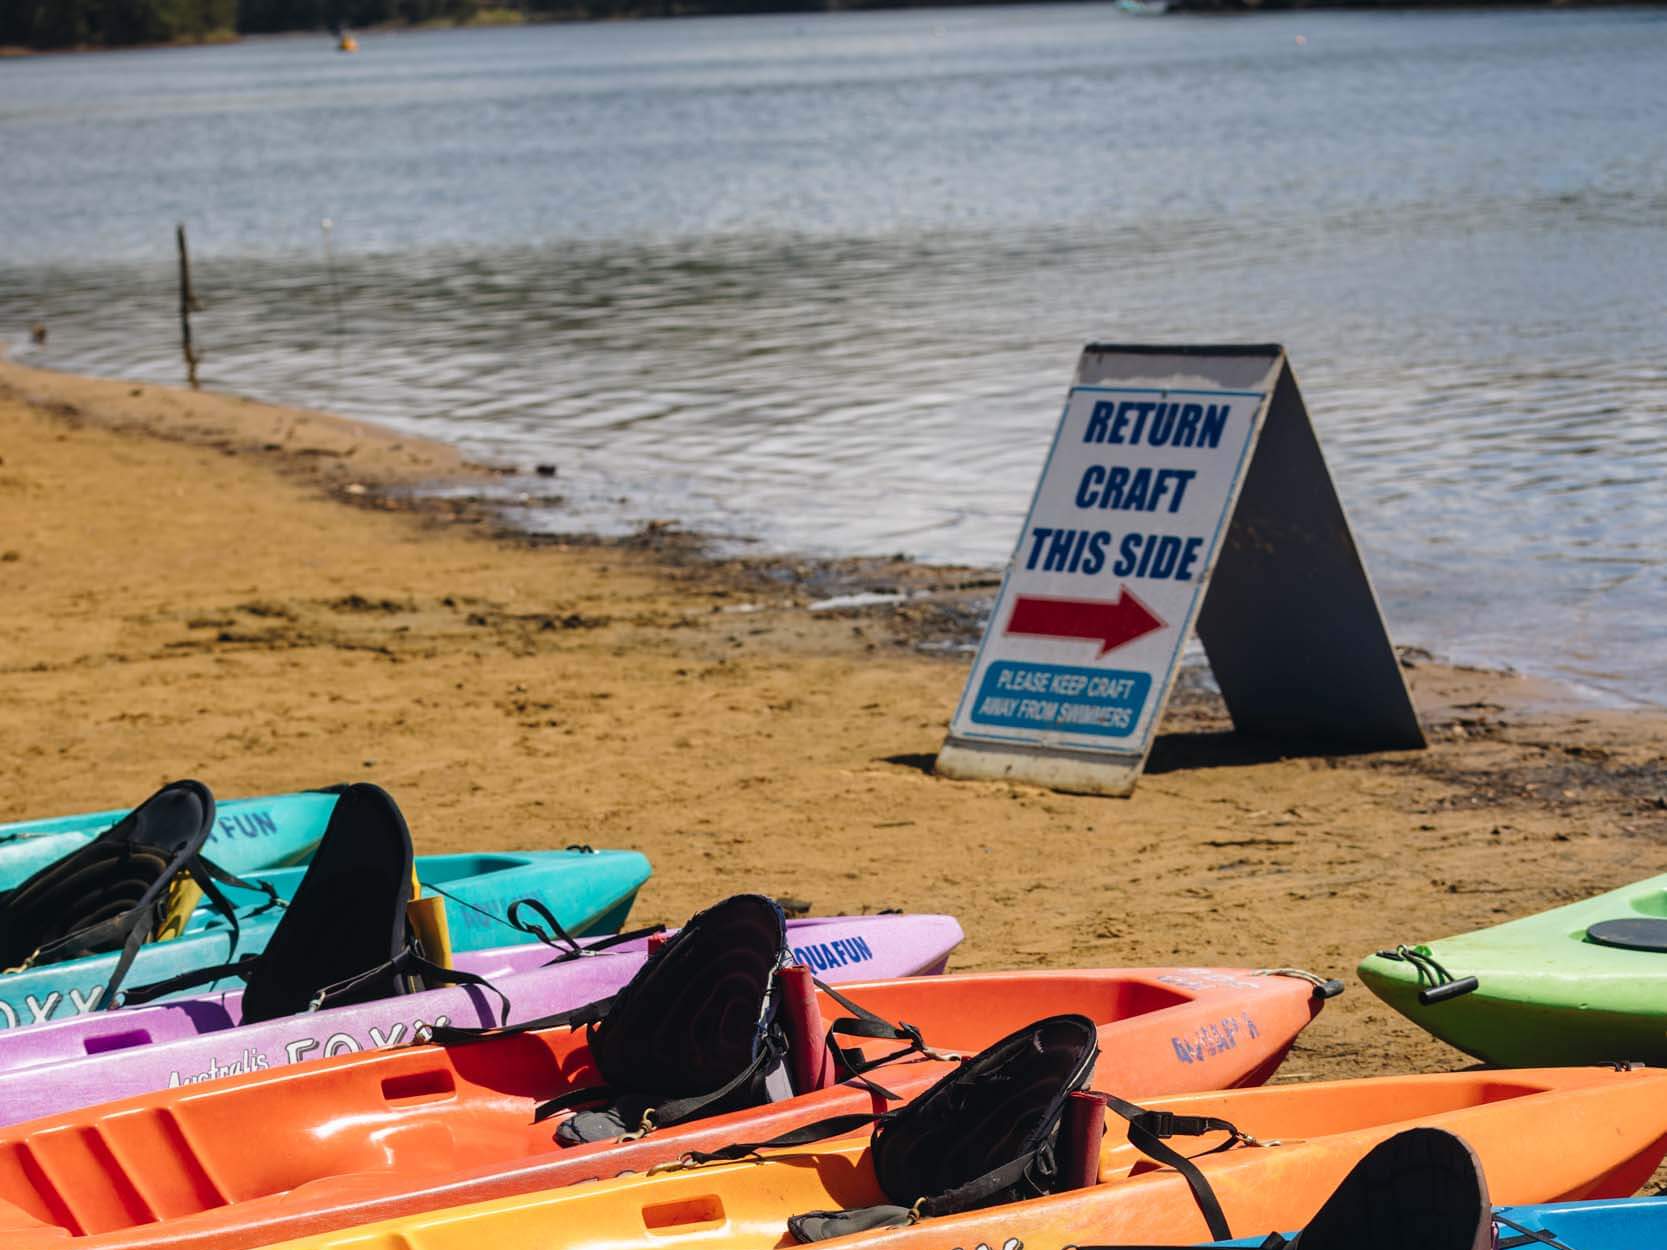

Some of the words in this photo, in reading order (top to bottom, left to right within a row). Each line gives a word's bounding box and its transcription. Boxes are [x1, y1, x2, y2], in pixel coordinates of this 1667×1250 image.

[1082, 400, 1231, 449] RETURN
[1075, 465, 1197, 513] CRAFT
[1026, 527, 1111, 575] THIS
[1113, 532, 1204, 581] SIDE
[996, 669, 1051, 693] PLEASE
[1051, 674, 1088, 697] KEEP
[1087, 677, 1135, 700] CRAFT
[978, 697, 1020, 718] AWAY
[1017, 698, 1059, 722] FROM
[1056, 702, 1134, 729] SWIMMERS
[207, 811, 277, 843] FUN
